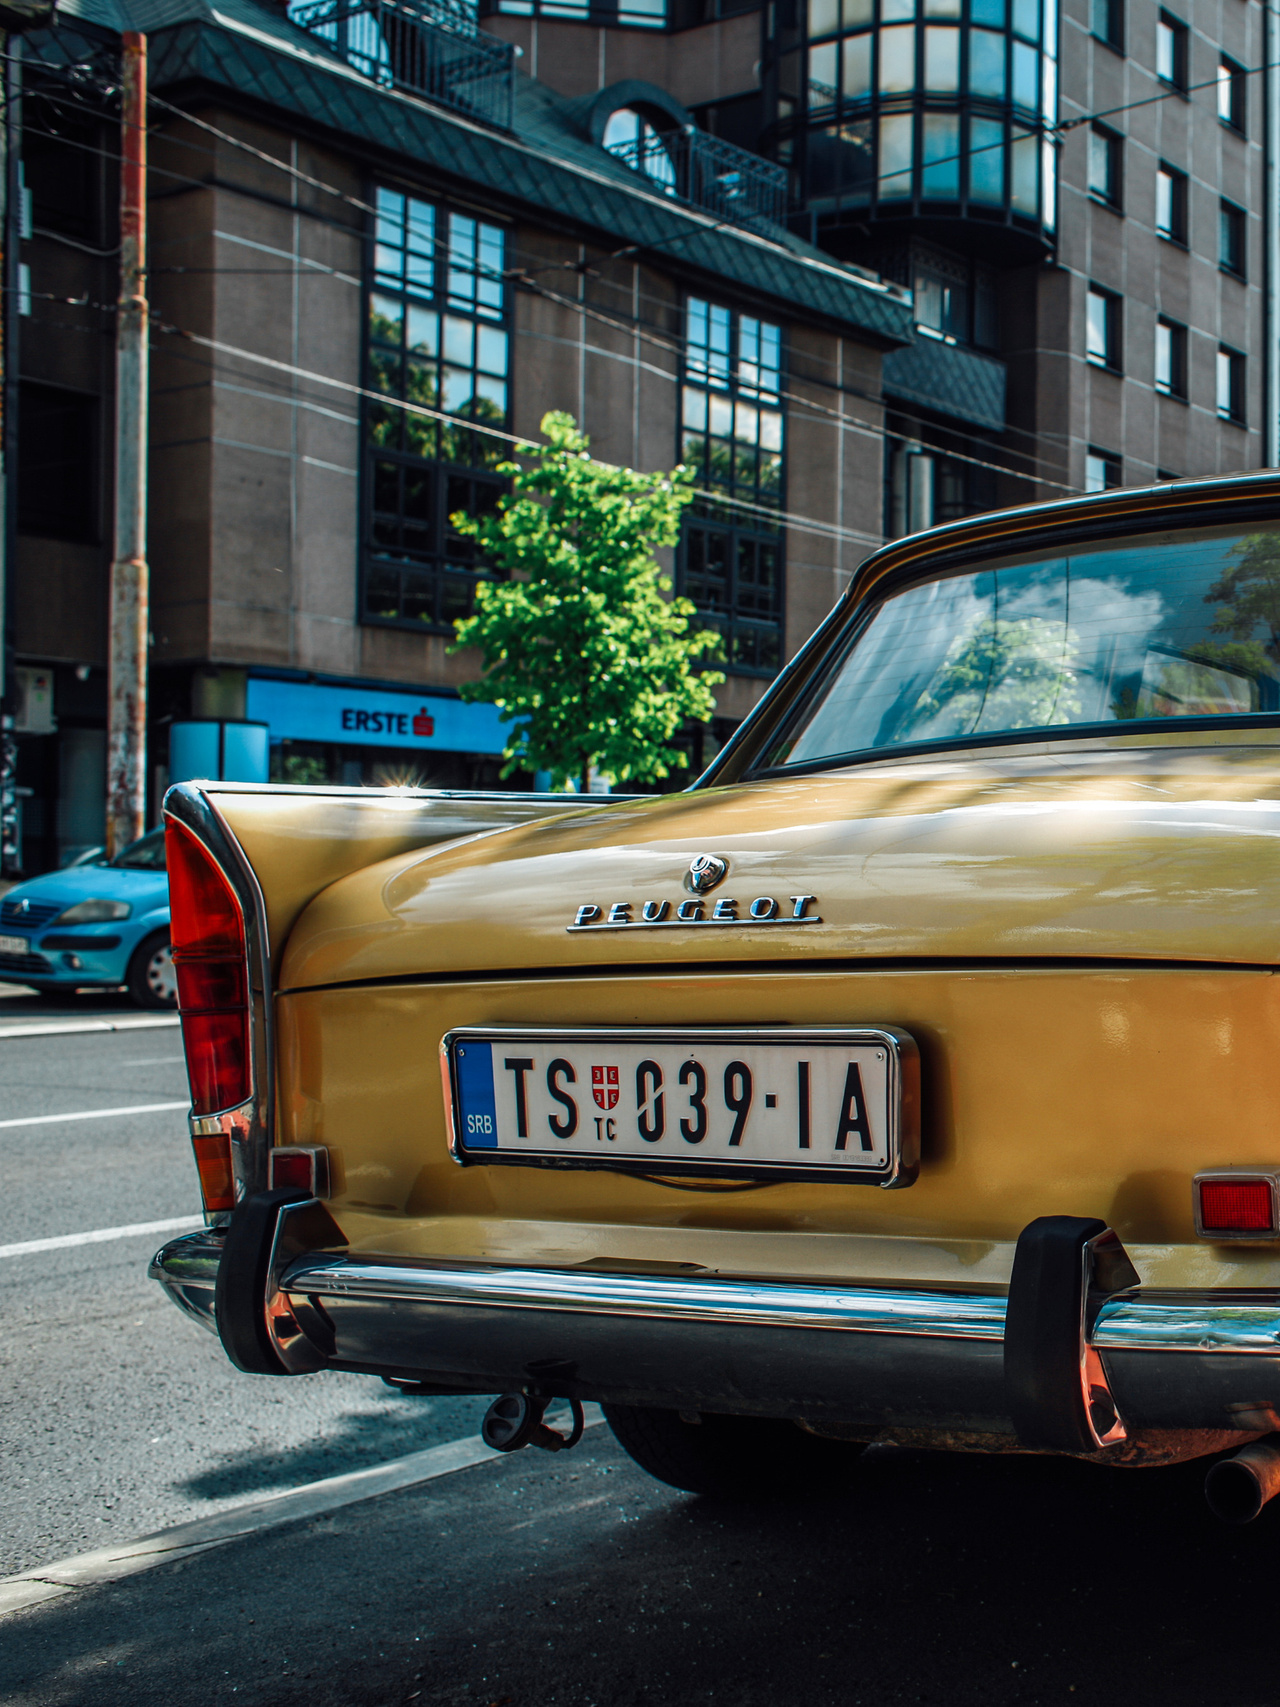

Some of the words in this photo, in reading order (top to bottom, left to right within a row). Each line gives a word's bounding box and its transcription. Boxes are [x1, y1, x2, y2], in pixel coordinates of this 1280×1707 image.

[342, 708, 408, 735] ERSTE
[574, 895, 818, 926] PEUGEOT
[504, 1057, 579, 1139] TS
[467, 1114, 493, 1135] SRB
